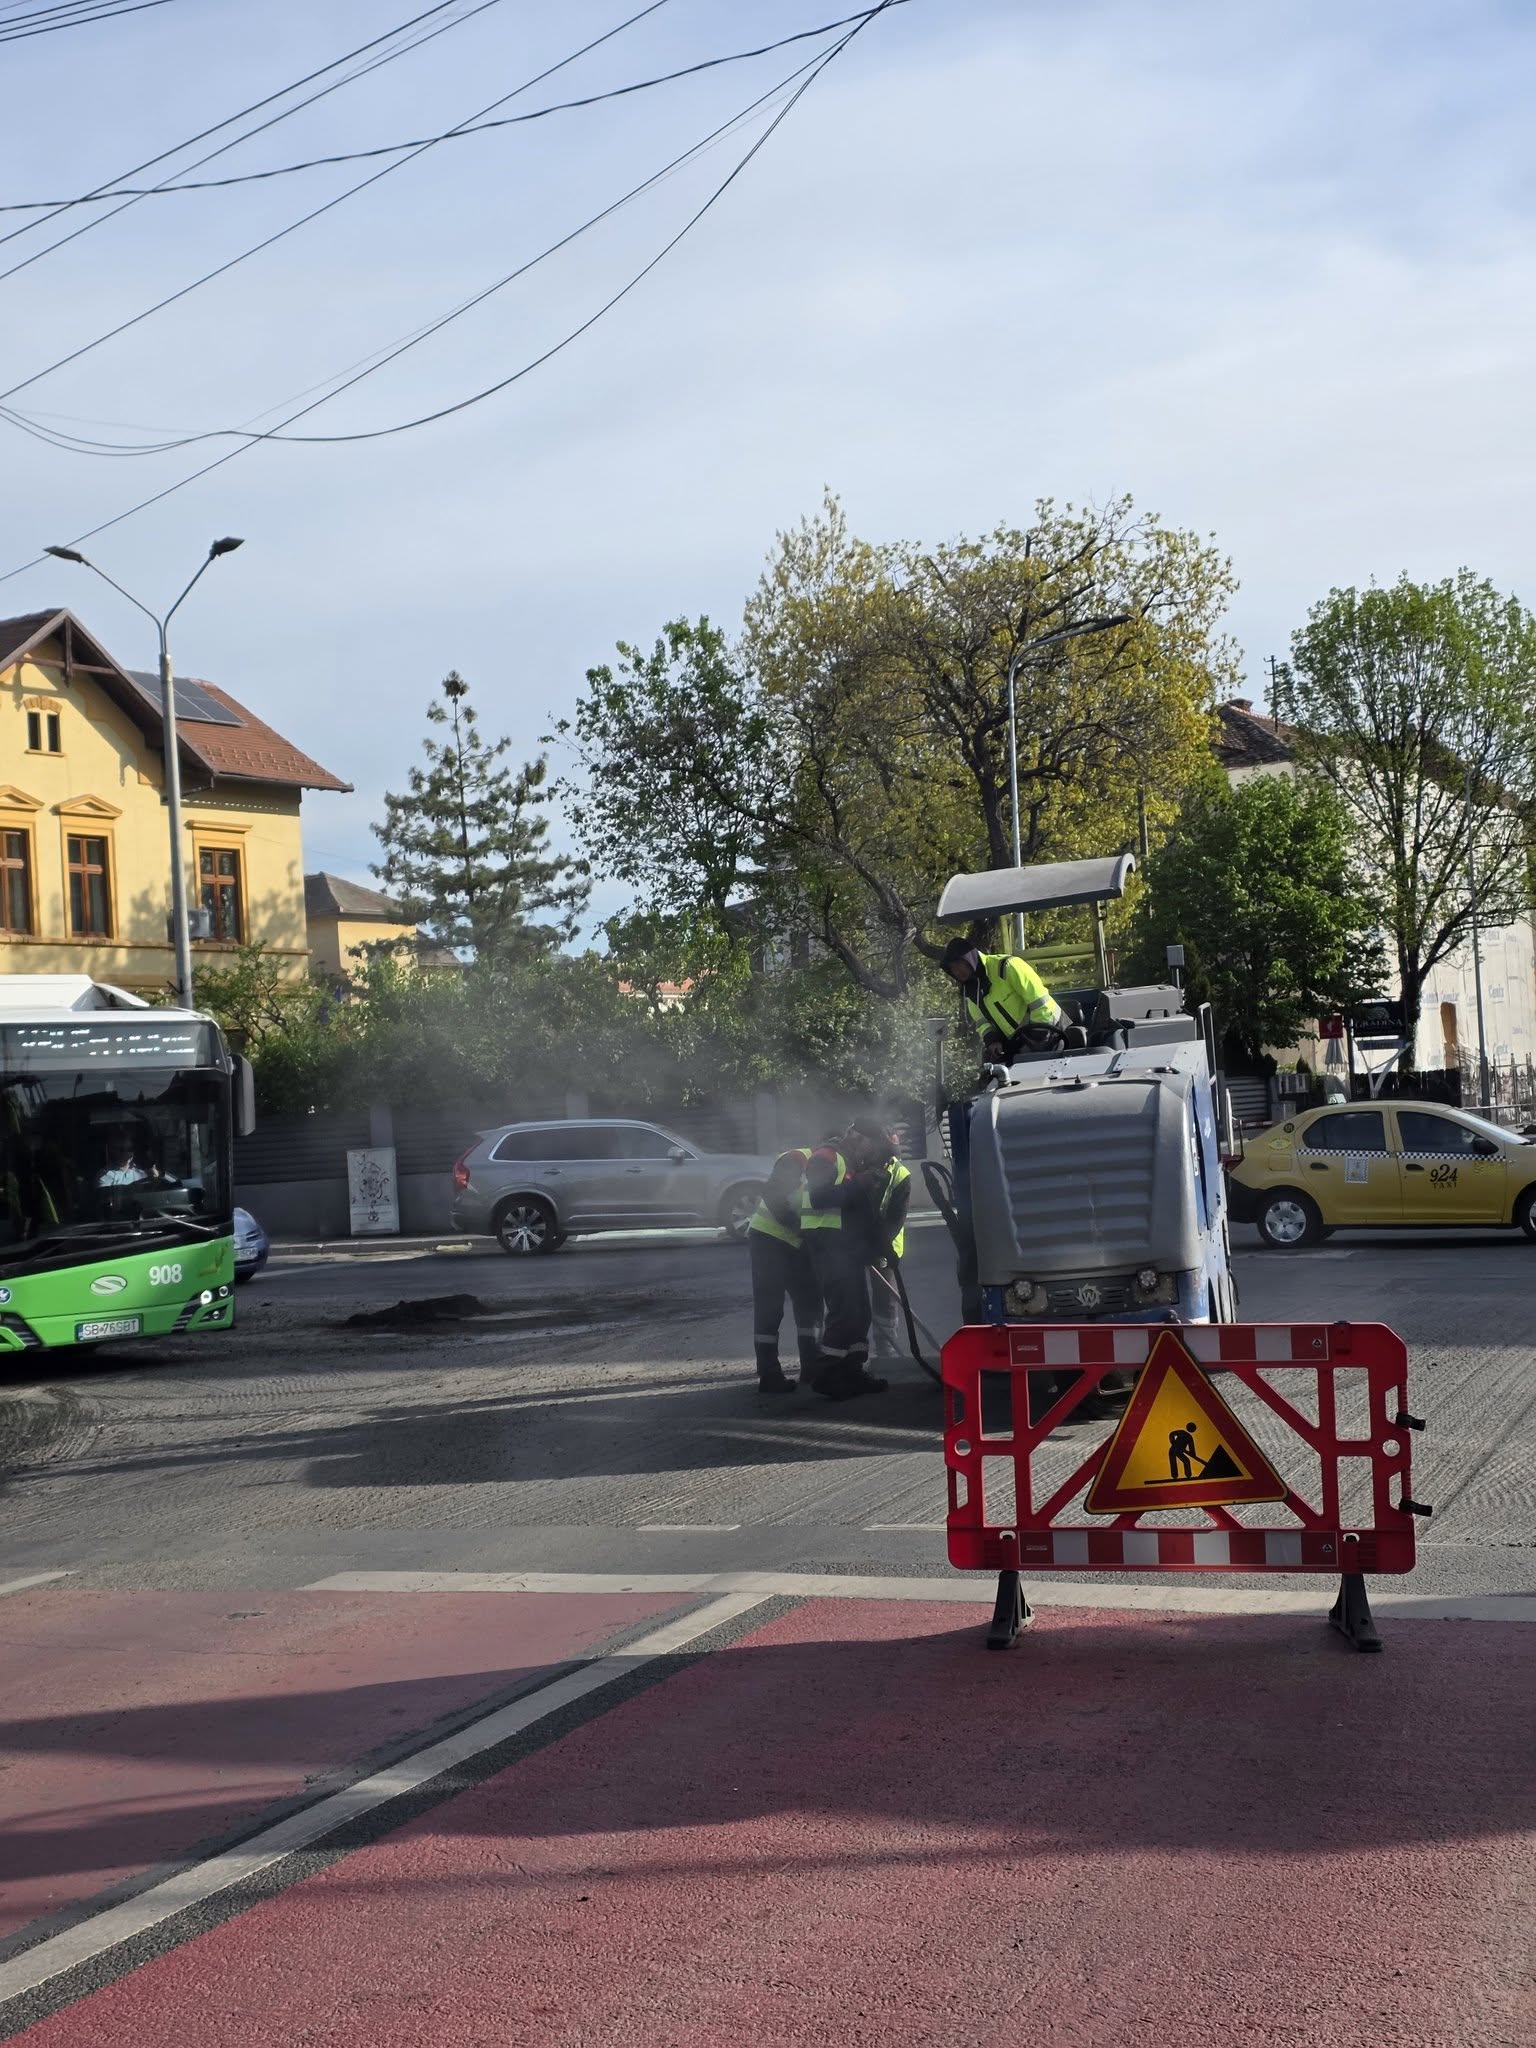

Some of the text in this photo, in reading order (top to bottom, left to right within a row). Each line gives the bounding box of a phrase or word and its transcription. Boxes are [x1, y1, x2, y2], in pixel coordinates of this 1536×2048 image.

[1430, 1163, 1458, 1182] 924
[1433, 1181, 1458, 1190] TAXI
[149, 1263, 183, 1286] 908
